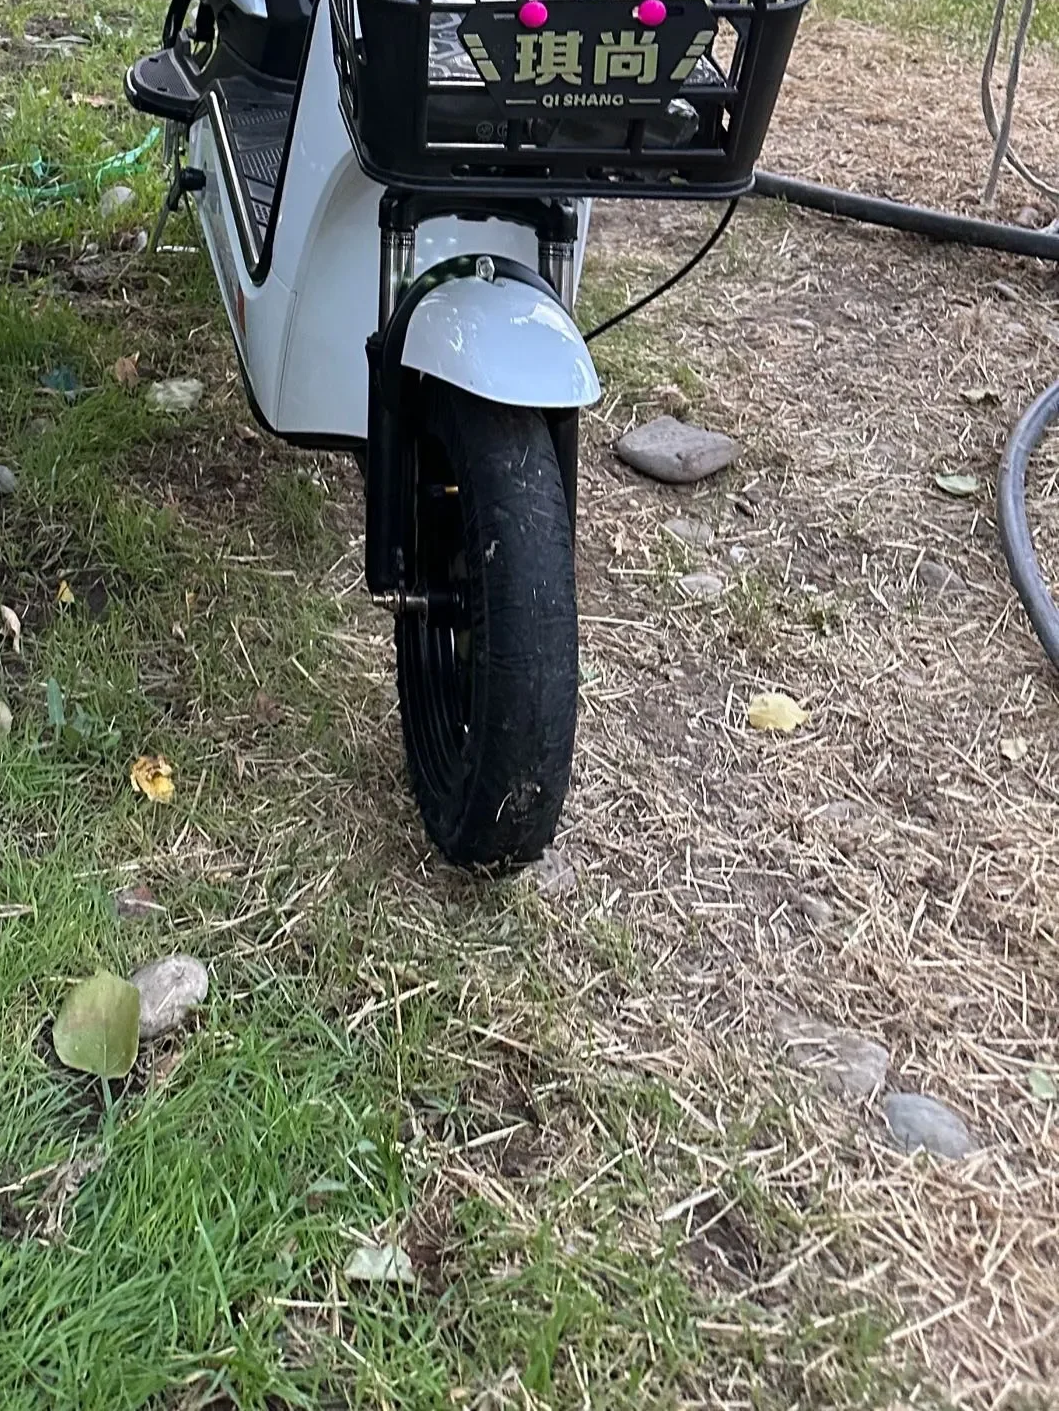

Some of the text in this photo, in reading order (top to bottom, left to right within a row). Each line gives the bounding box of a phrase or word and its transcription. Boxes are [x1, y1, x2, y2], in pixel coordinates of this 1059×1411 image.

[513, 30, 660, 86] 琪尚
[542, 93, 625, 109] QI SHANG
